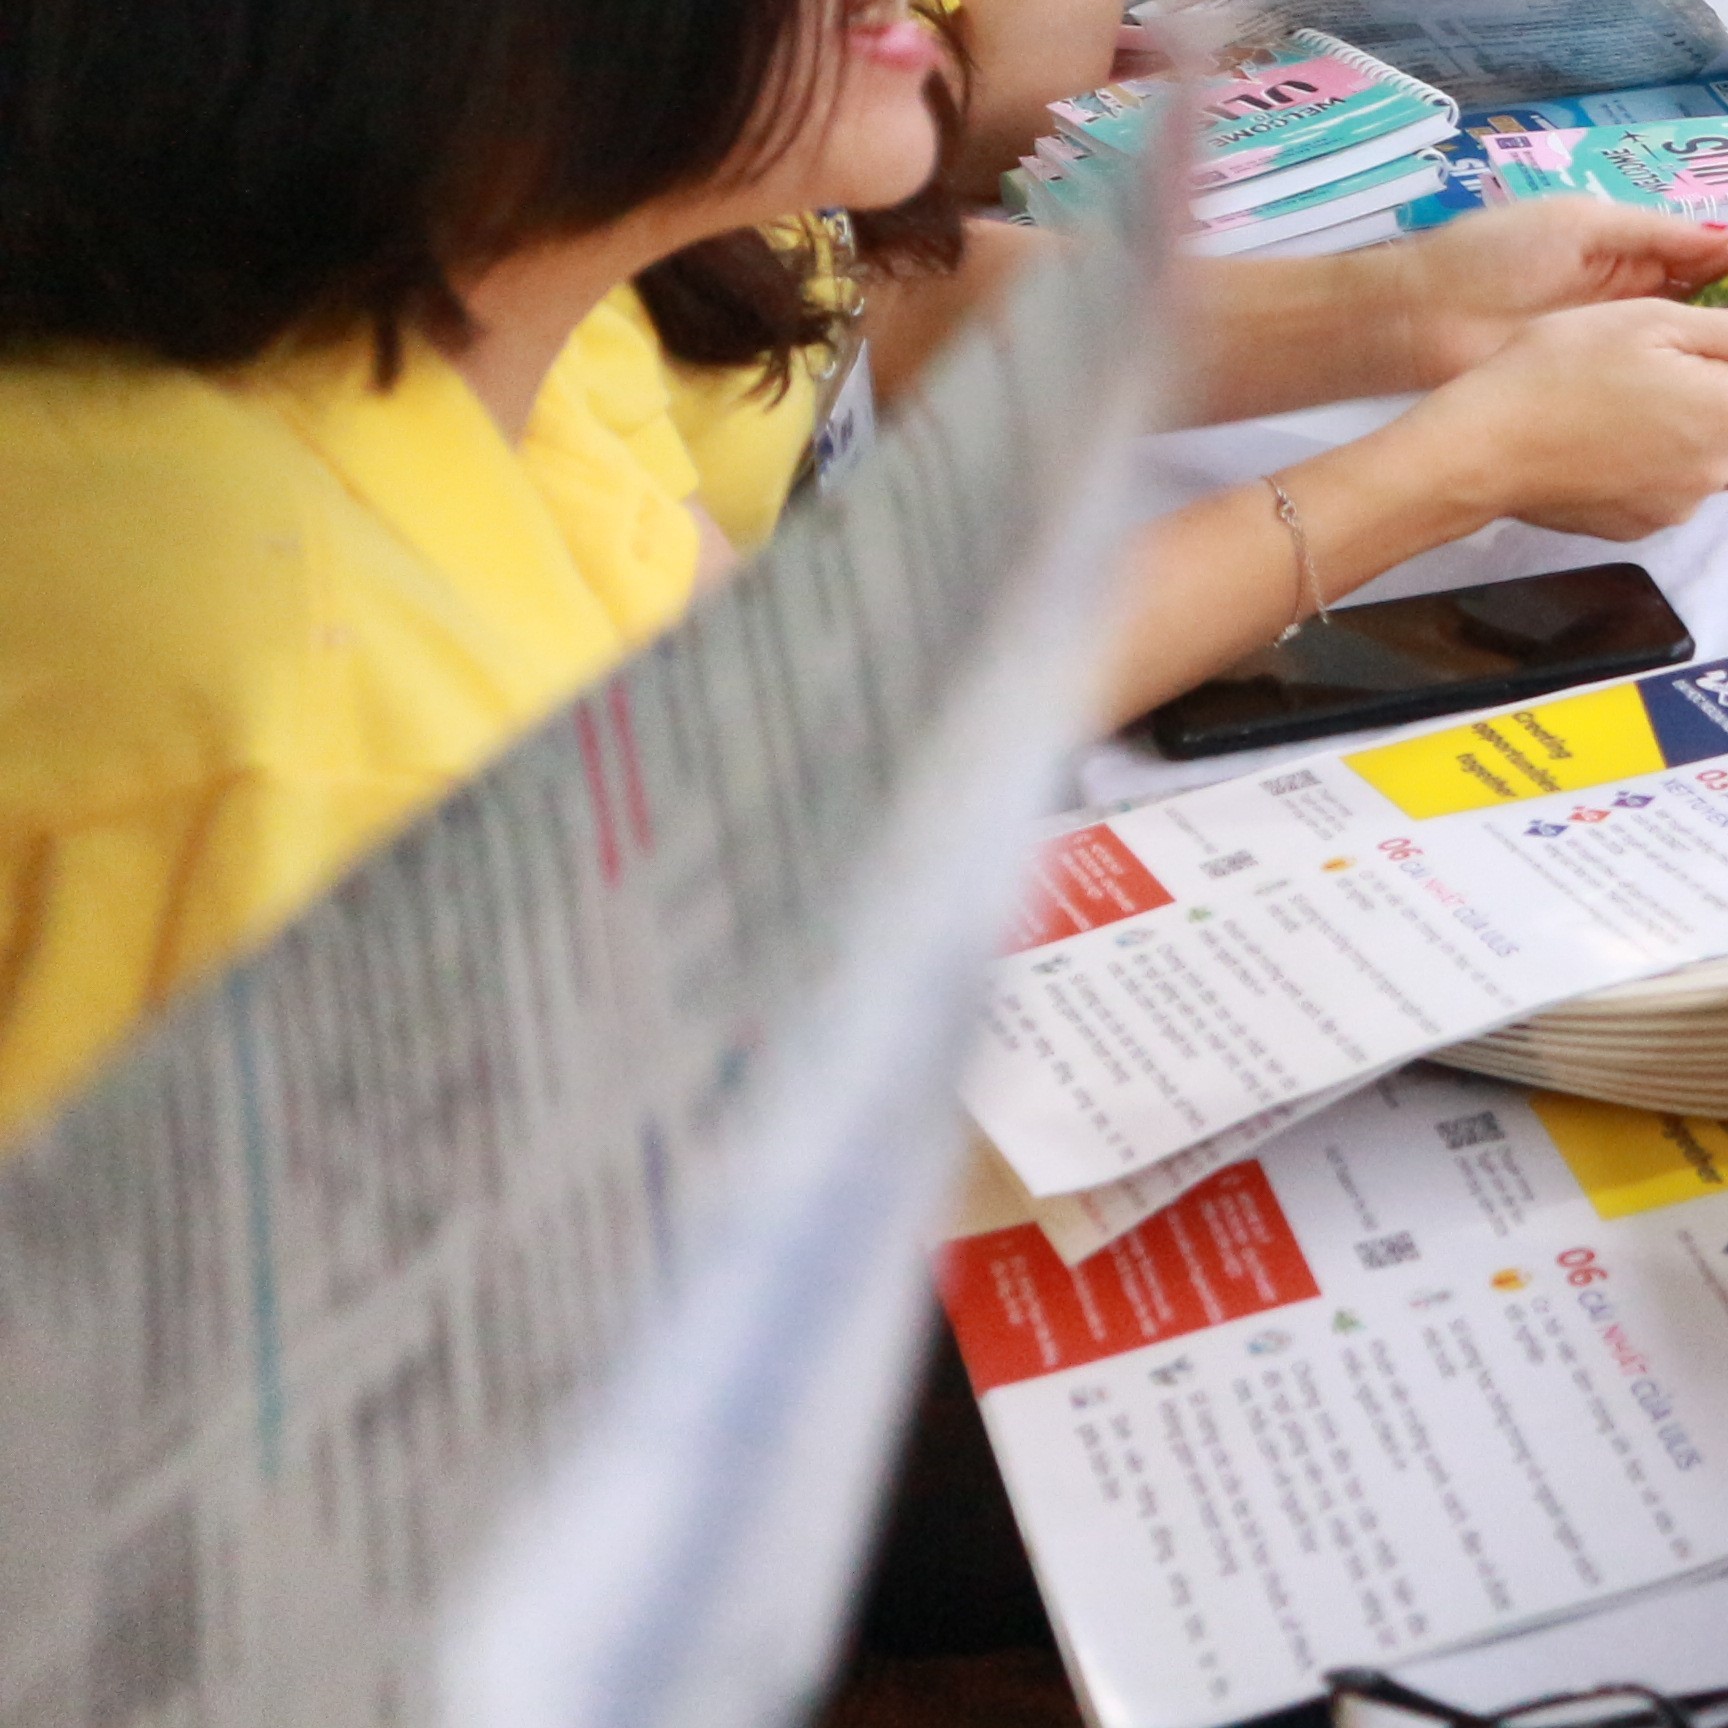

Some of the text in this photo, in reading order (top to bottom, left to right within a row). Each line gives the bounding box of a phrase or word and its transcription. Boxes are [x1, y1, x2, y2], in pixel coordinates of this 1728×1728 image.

[1603, 147, 1677, 194] WELCOME
[1377, 836, 1425, 862] 06
[1556, 1246, 1609, 1287] 06
